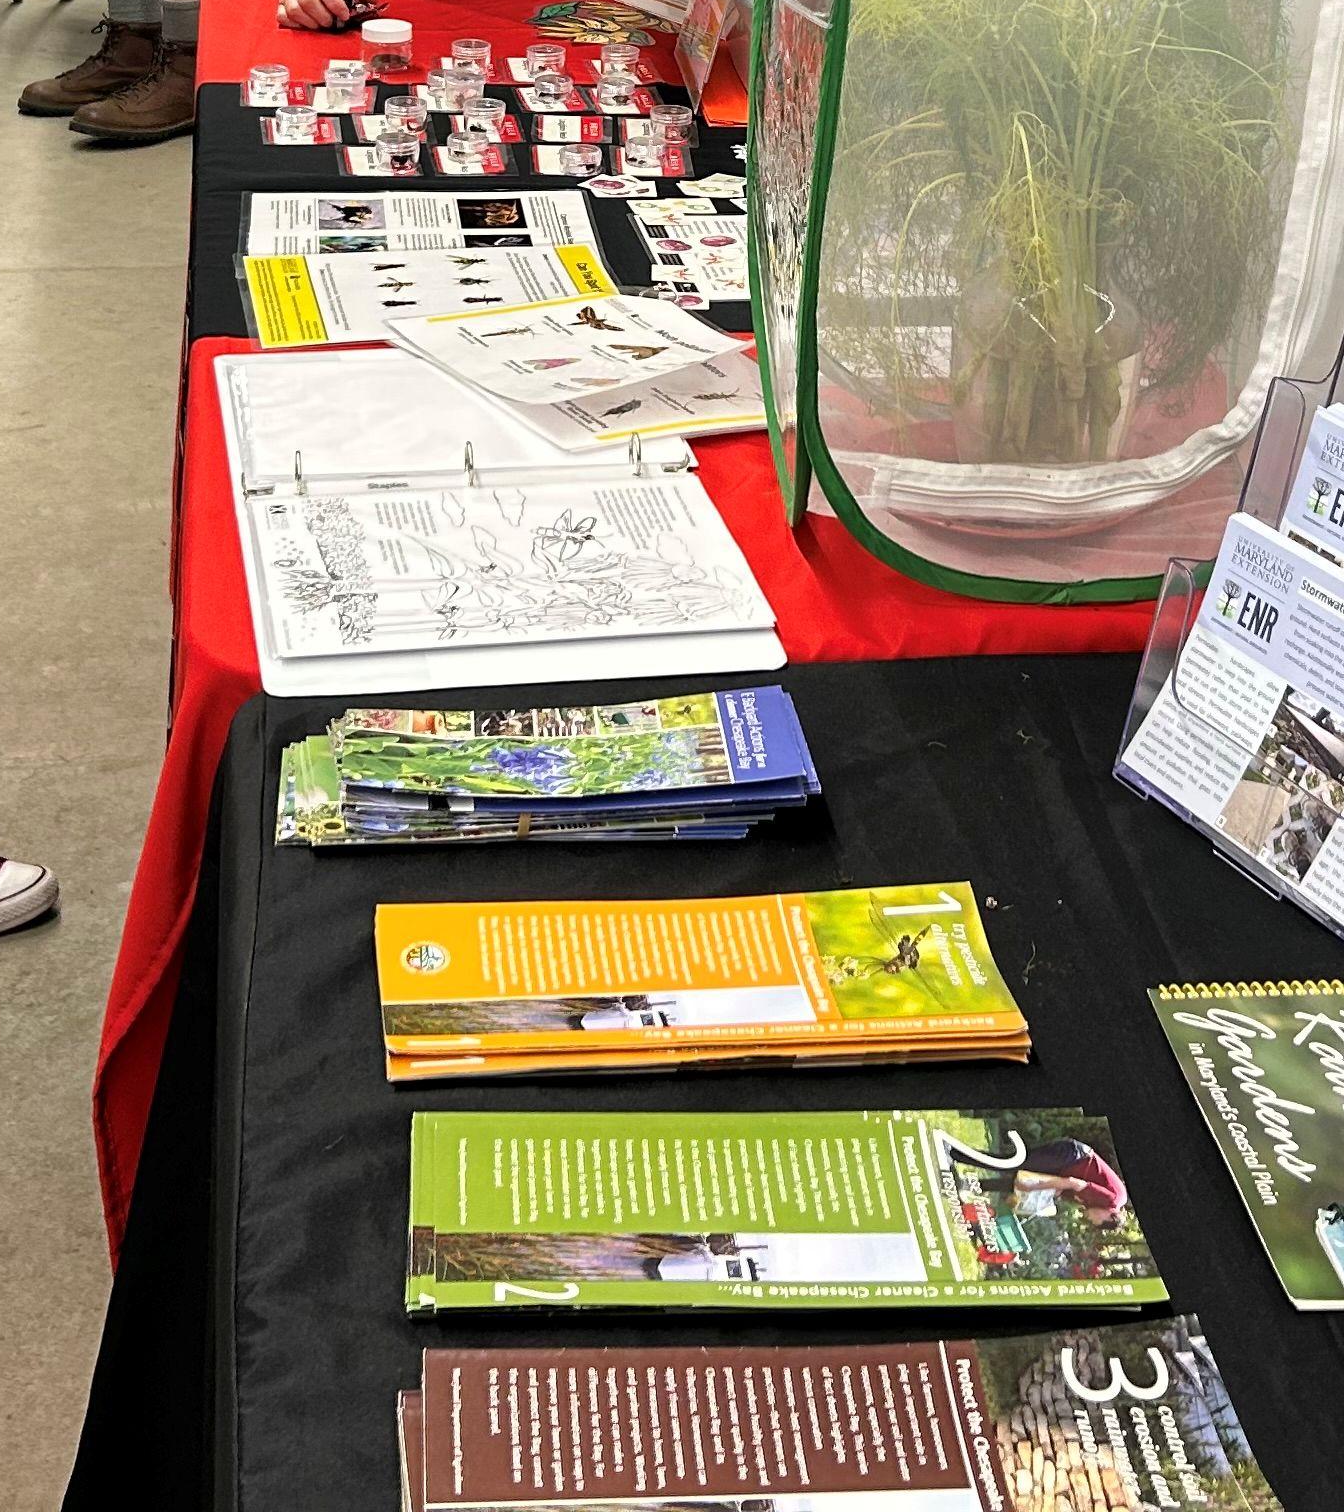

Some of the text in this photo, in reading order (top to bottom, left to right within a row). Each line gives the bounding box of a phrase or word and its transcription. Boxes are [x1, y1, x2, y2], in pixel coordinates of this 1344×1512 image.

[1228, 552, 1291, 595] EXTENSION
[1232, 541, 1295, 586] MARYLAND
[1231, 592, 1286, 645] ENR
[882, 889, 964, 917] 1
[1174, 1007, 1318, 1184] Gardens
[1187, 1037, 1283, 1207] in Maryland's Coastal Plain
[934, 1128, 1028, 1173] 2
[874, 1285, 938, 1298] Cleaner
[986, 1284, 1051, 1297] Actions
[1057, 1282, 1133, 1296] Backyard
[955, 1357, 979, 1411] Protect
[1060, 1347, 1171, 1403] 3
[963, 1409, 984, 1436] the
[1154, 1403, 1193, 1474] control
[1128, 1404, 1177, 1512] erosion and
